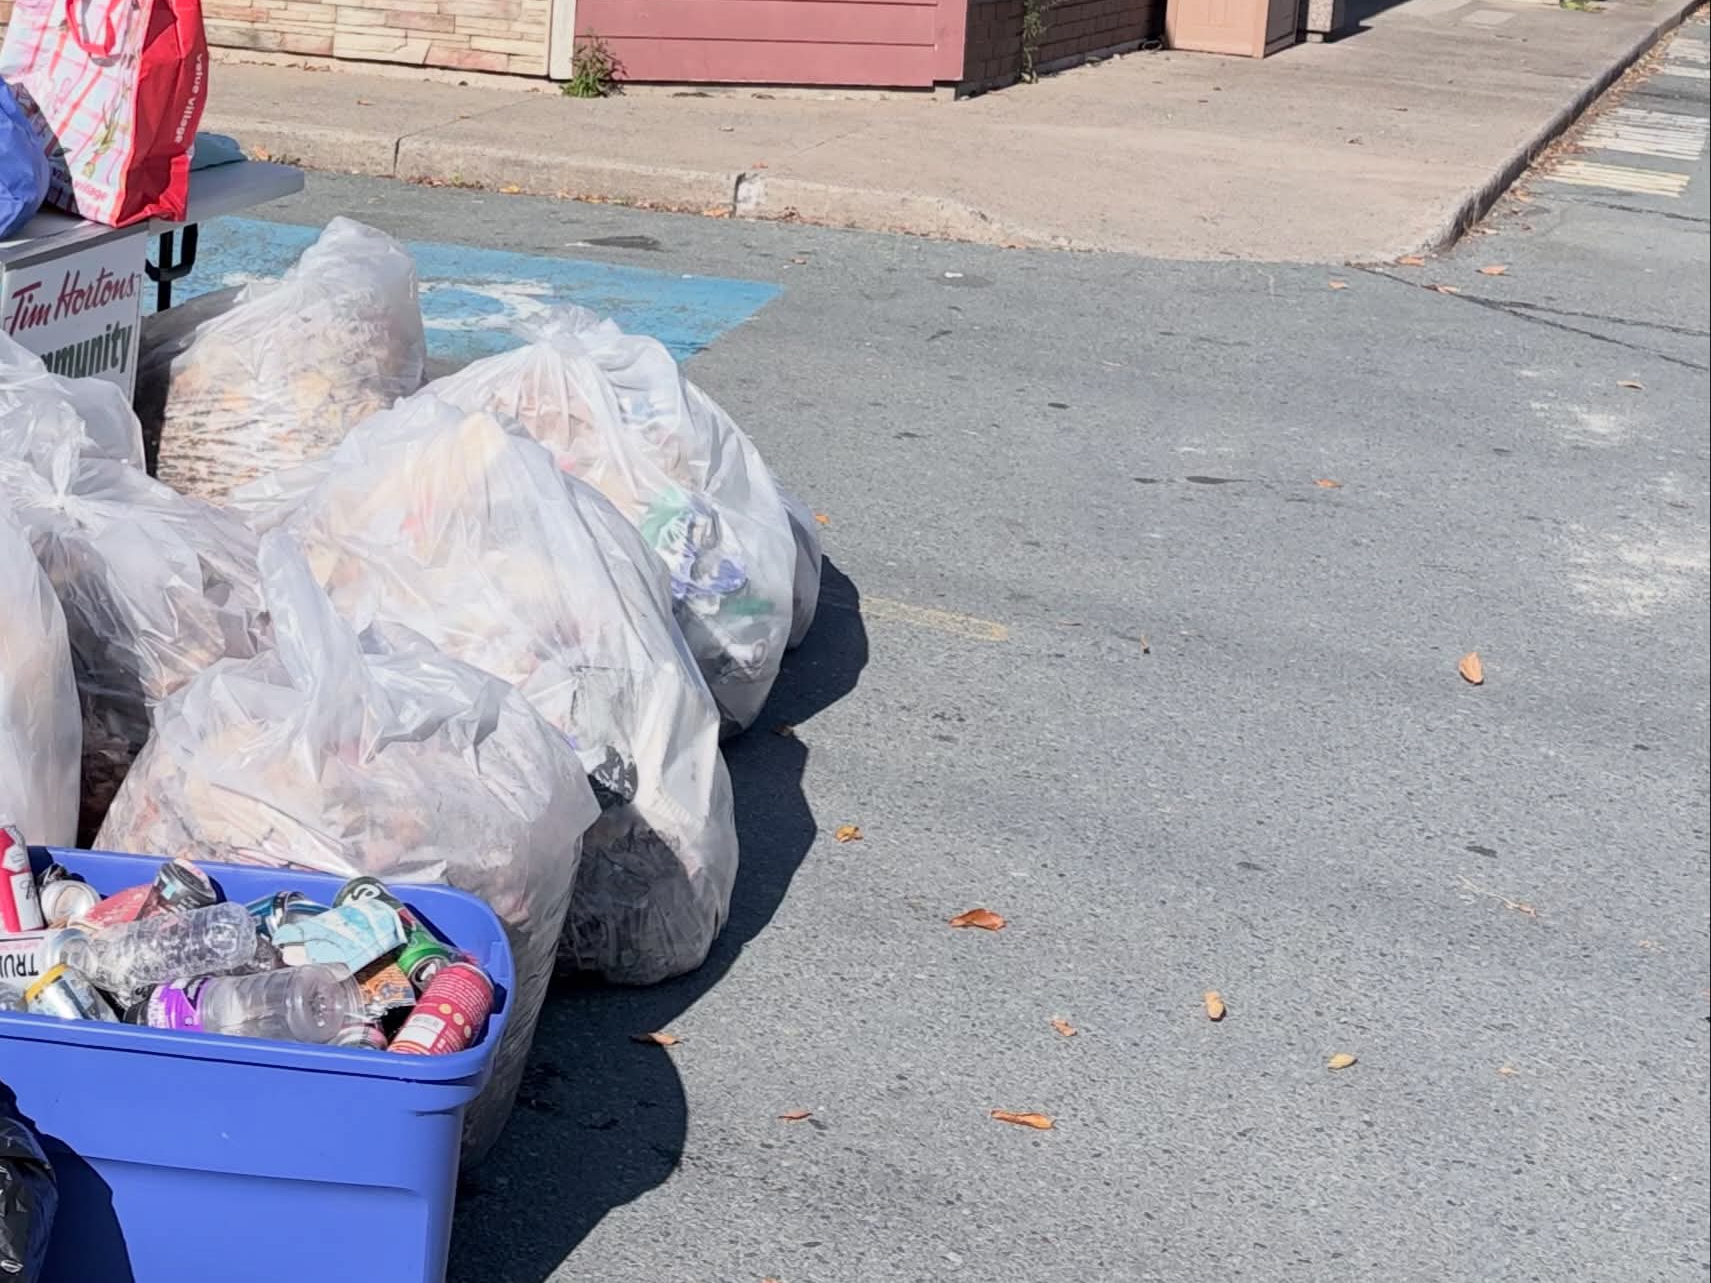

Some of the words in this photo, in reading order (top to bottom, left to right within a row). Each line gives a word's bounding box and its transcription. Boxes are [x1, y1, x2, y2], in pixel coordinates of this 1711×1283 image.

[173, 97, 197, 144] village
[8, 280, 53, 337] Tim
[53, 266, 136, 321] Hortons
[40, 320, 134, 379] mmunity
